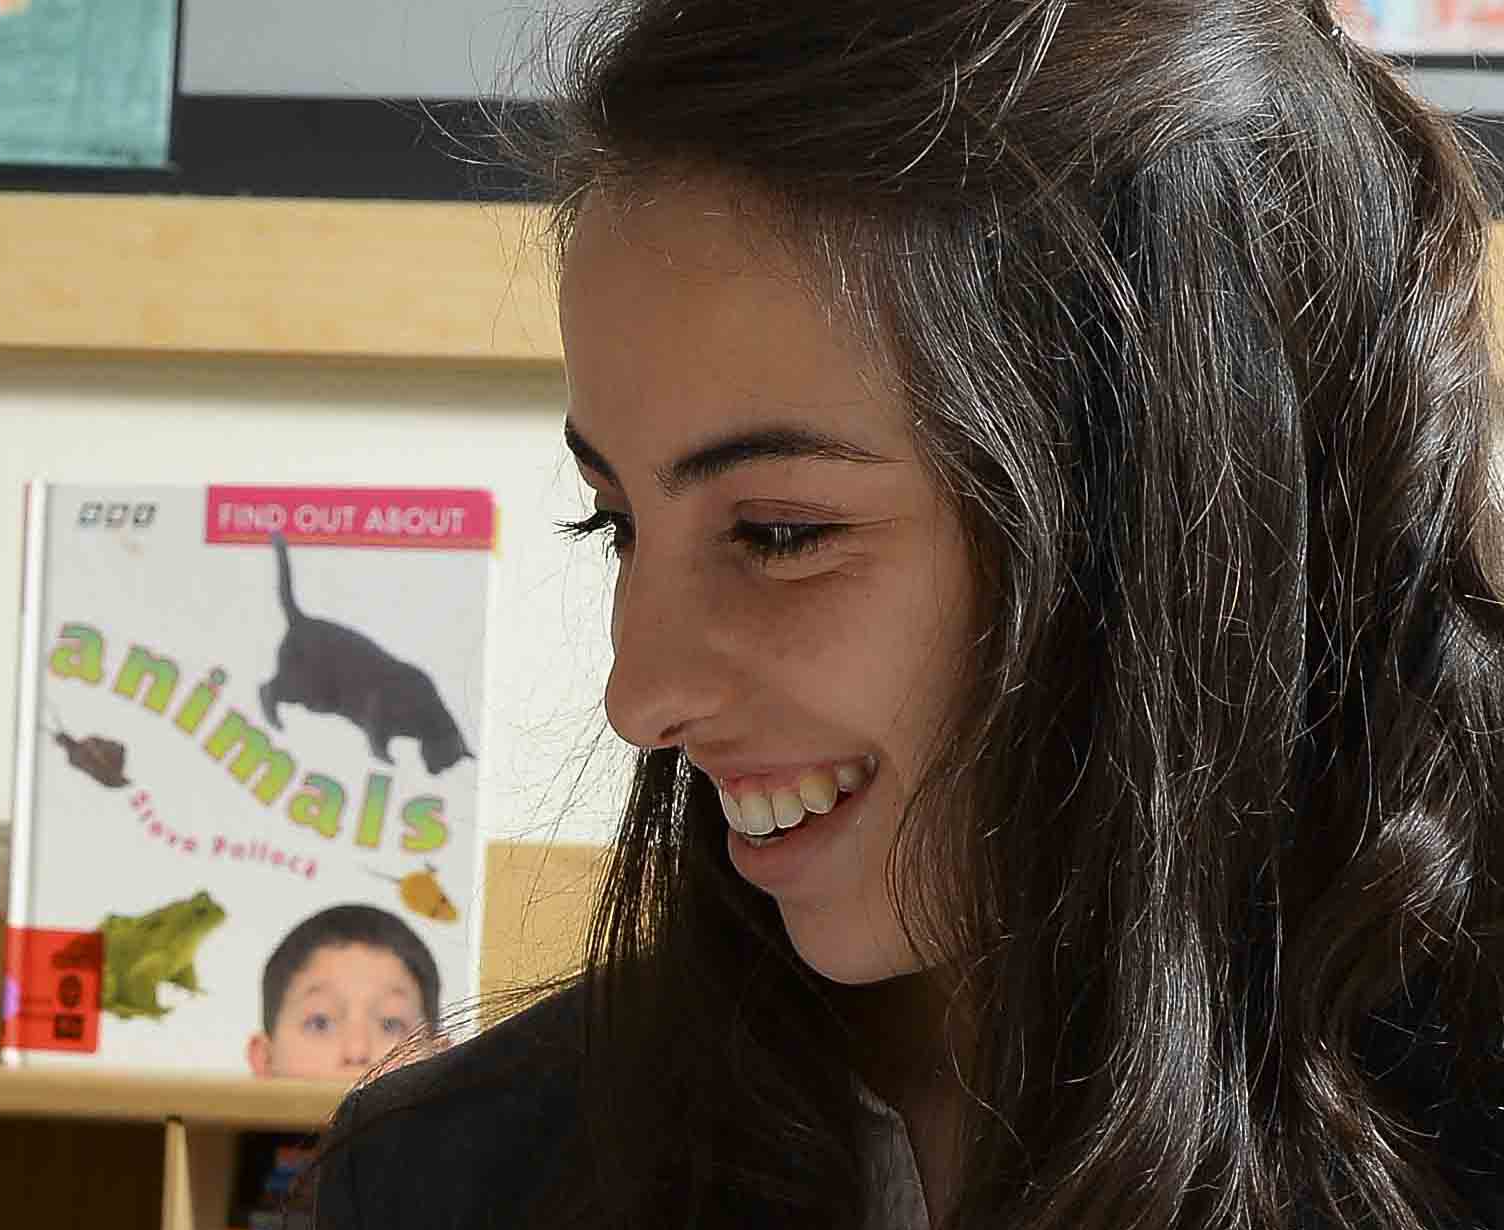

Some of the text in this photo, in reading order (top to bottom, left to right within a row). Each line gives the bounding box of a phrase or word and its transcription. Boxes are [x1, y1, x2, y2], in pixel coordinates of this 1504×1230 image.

[215, 502, 468, 537] FIND OUT ABOUT
[48, 621, 450, 855] animals
